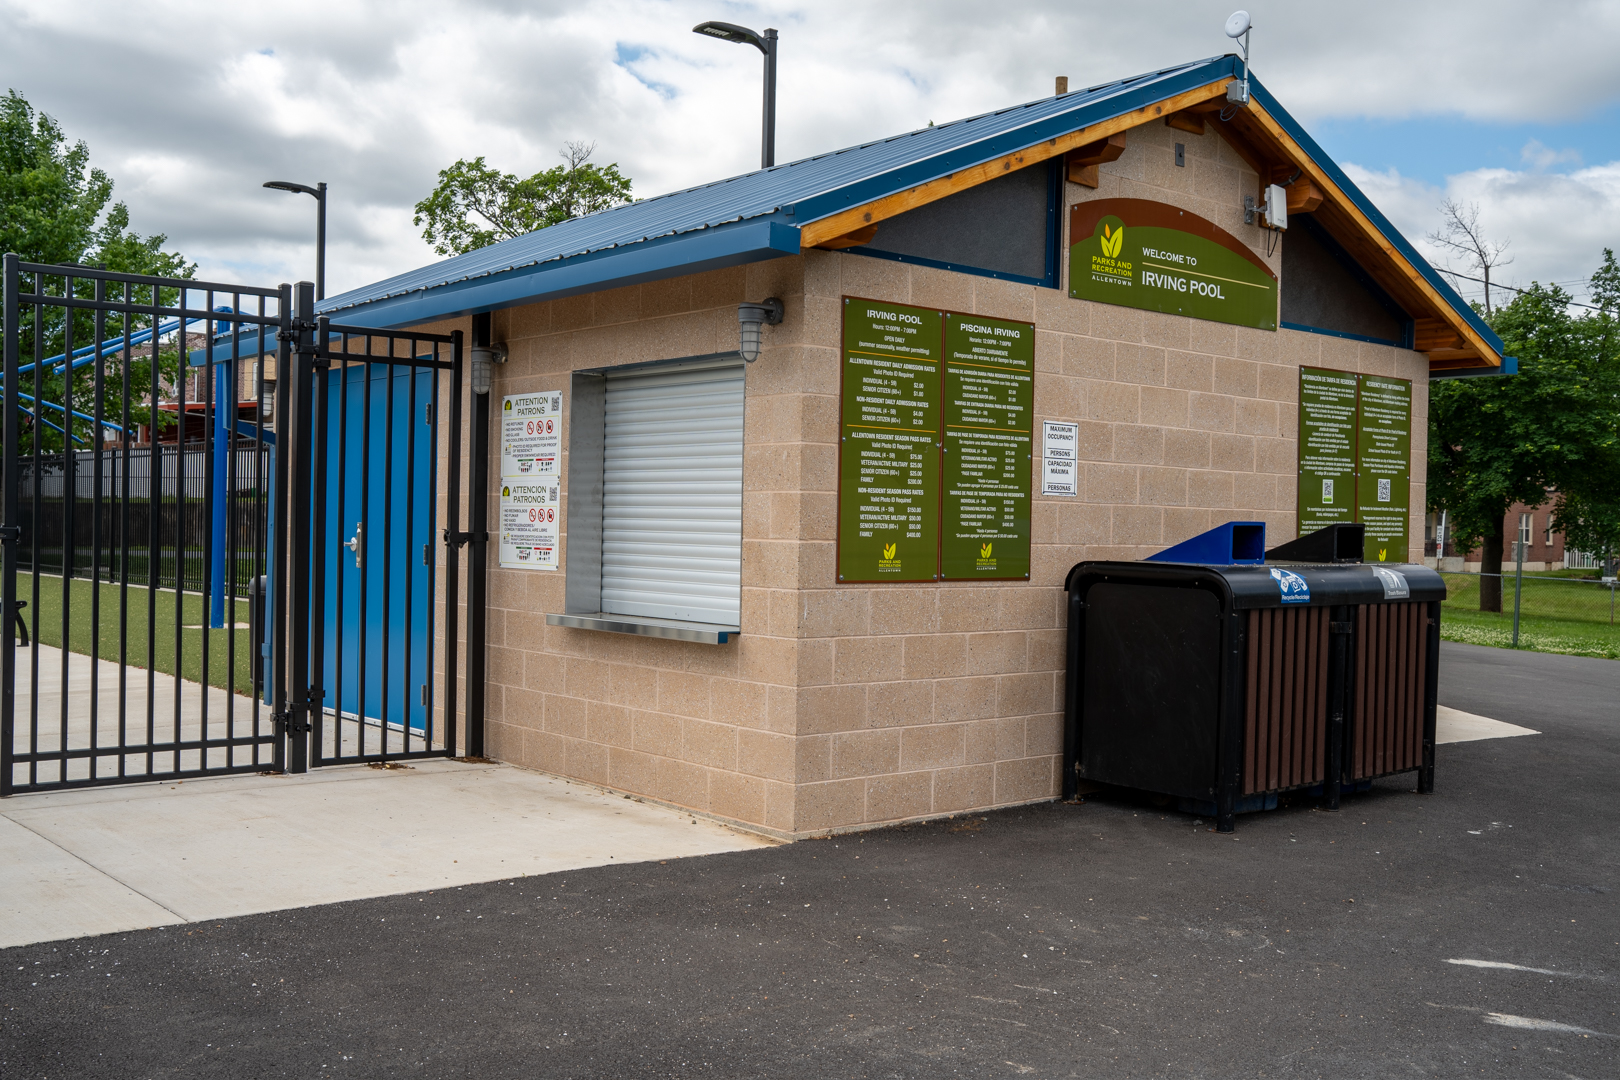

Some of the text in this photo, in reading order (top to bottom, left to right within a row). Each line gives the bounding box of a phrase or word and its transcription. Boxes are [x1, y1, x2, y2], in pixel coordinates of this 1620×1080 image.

[1143, 247, 1197, 266] WELCOME TO
[1092, 256, 1132, 269] PARKS AND
[1092, 264, 1132, 277] RECREATION
[1092, 275, 1132, 286] ALLENTOWN
[1142, 271, 1225, 300] IRVING POOL
[867, 309, 922, 325] IRVING POOL
[960, 323, 1020, 338] PISCINA IRVING
[859, 341, 875, 349] (summer
[849, 357, 873, 365] ALLENTOWN
[863, 377, 883, 385] INDIVIDUAL
[515, 396, 548, 406] ATTENTION
[856, 396, 884, 404] NON-RESIDENT
[518, 407, 545, 416] PATRONS
[1048, 433, 1073, 441] OCCUPANCY
